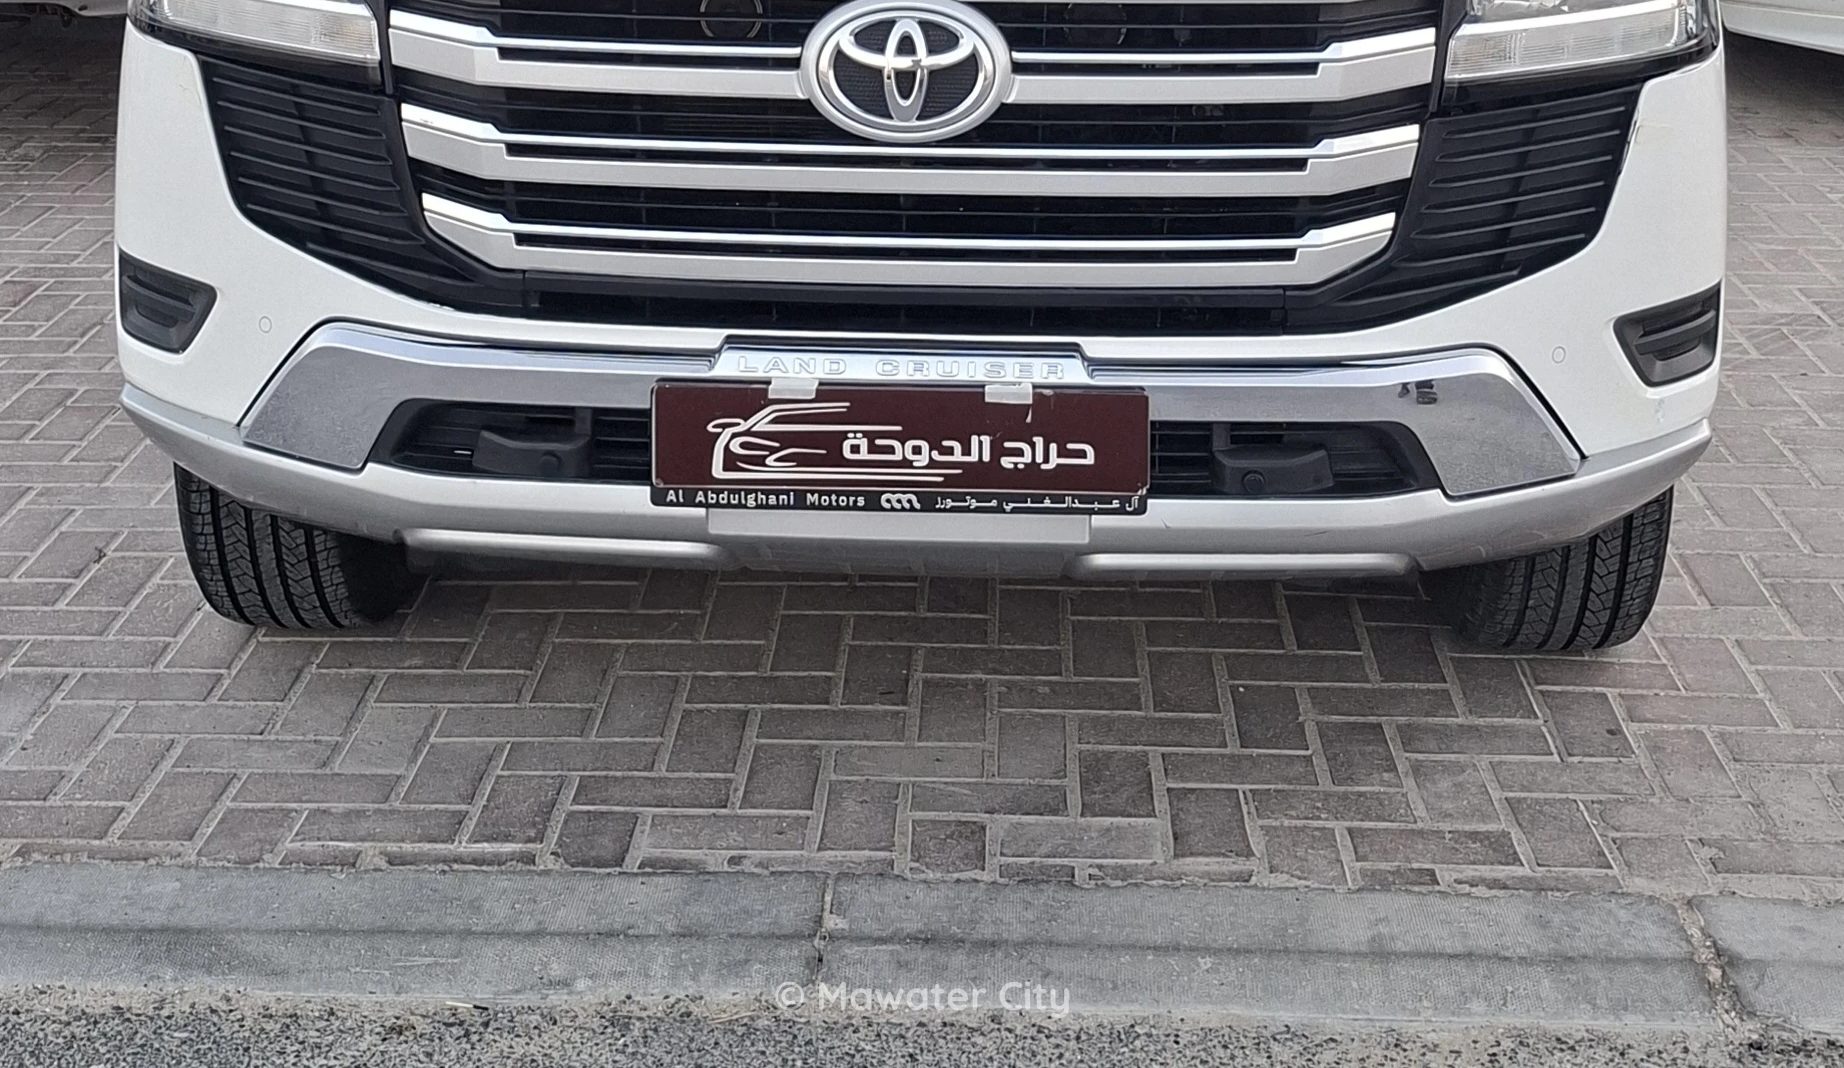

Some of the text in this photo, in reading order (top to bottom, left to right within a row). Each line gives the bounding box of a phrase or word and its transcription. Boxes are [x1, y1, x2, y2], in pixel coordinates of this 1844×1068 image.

[737, 355, 1065, 380] LAND CRUISER
[841, 432, 1096, 470] حراج الدوحة
[666, 489, 866, 508] Al Abdulghani Motors
[935, 494, 998, 509] موتورز
